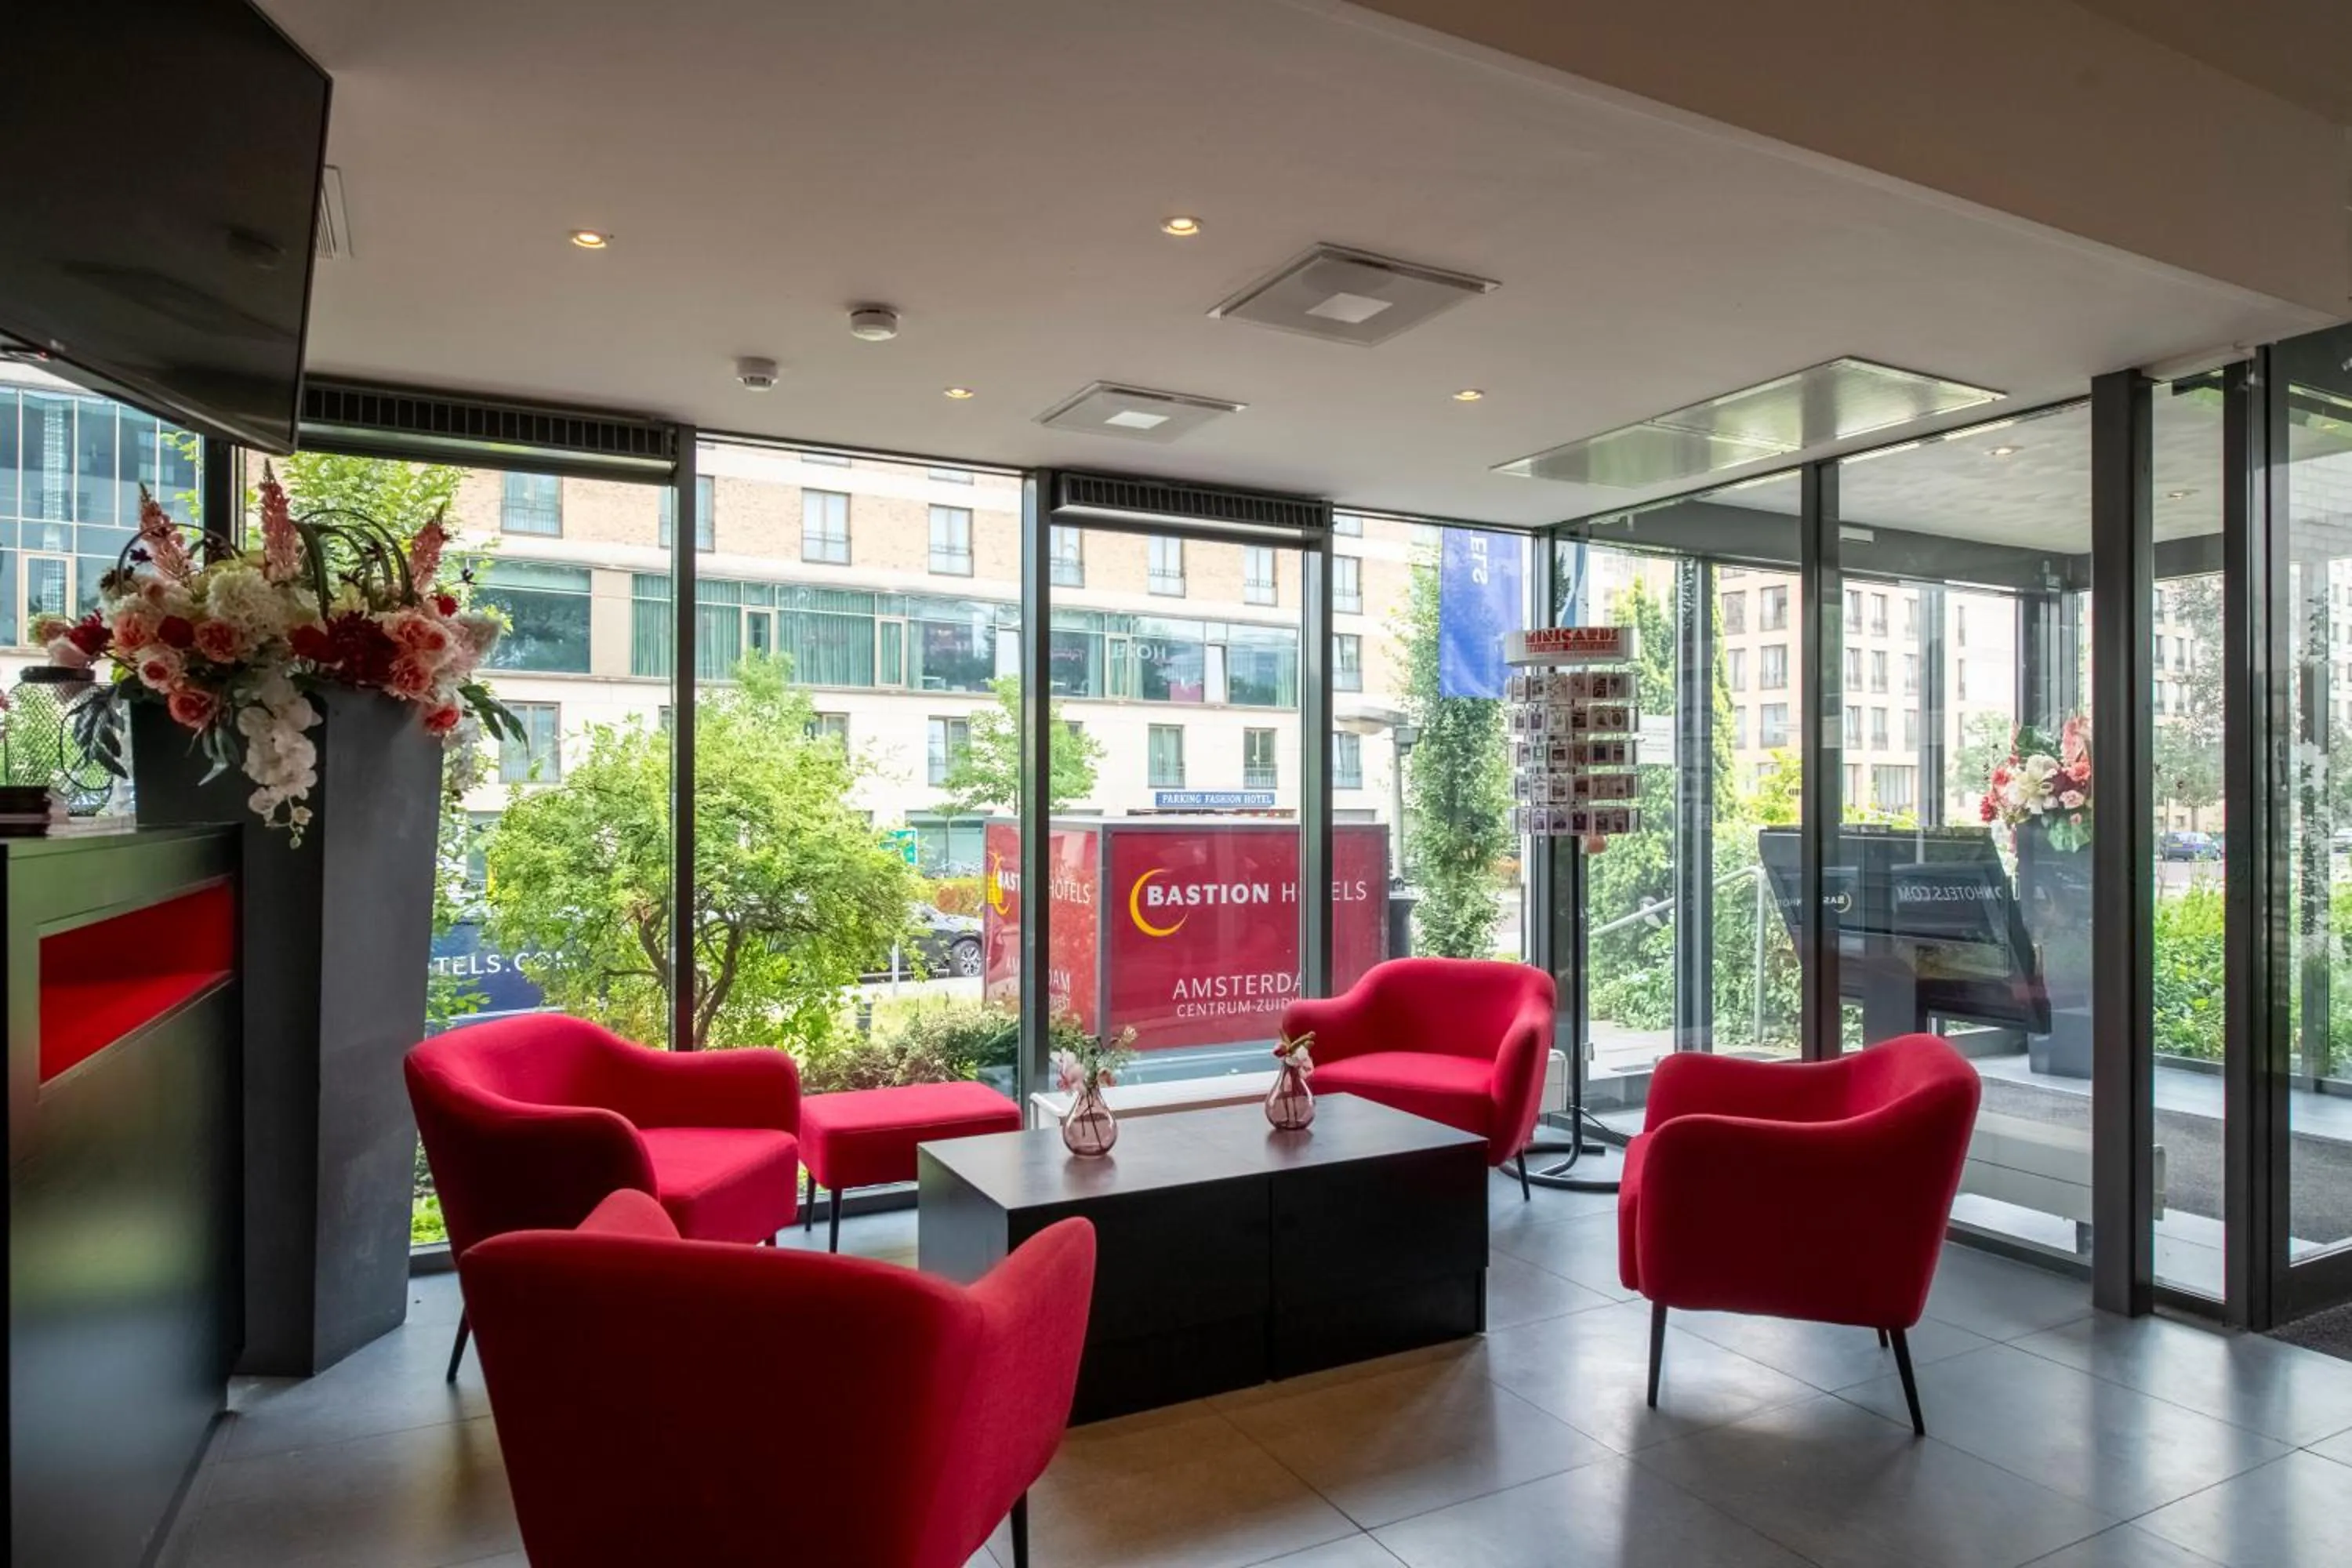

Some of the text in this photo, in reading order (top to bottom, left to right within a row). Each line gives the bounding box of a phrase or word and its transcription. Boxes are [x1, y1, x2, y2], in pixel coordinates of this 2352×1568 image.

[1162, 793, 1272, 804] PARKING FASHION HOTEL
[1147, 880, 1367, 906] BASTION HELS
[1172, 971, 1302, 1000] AMSTERDA
